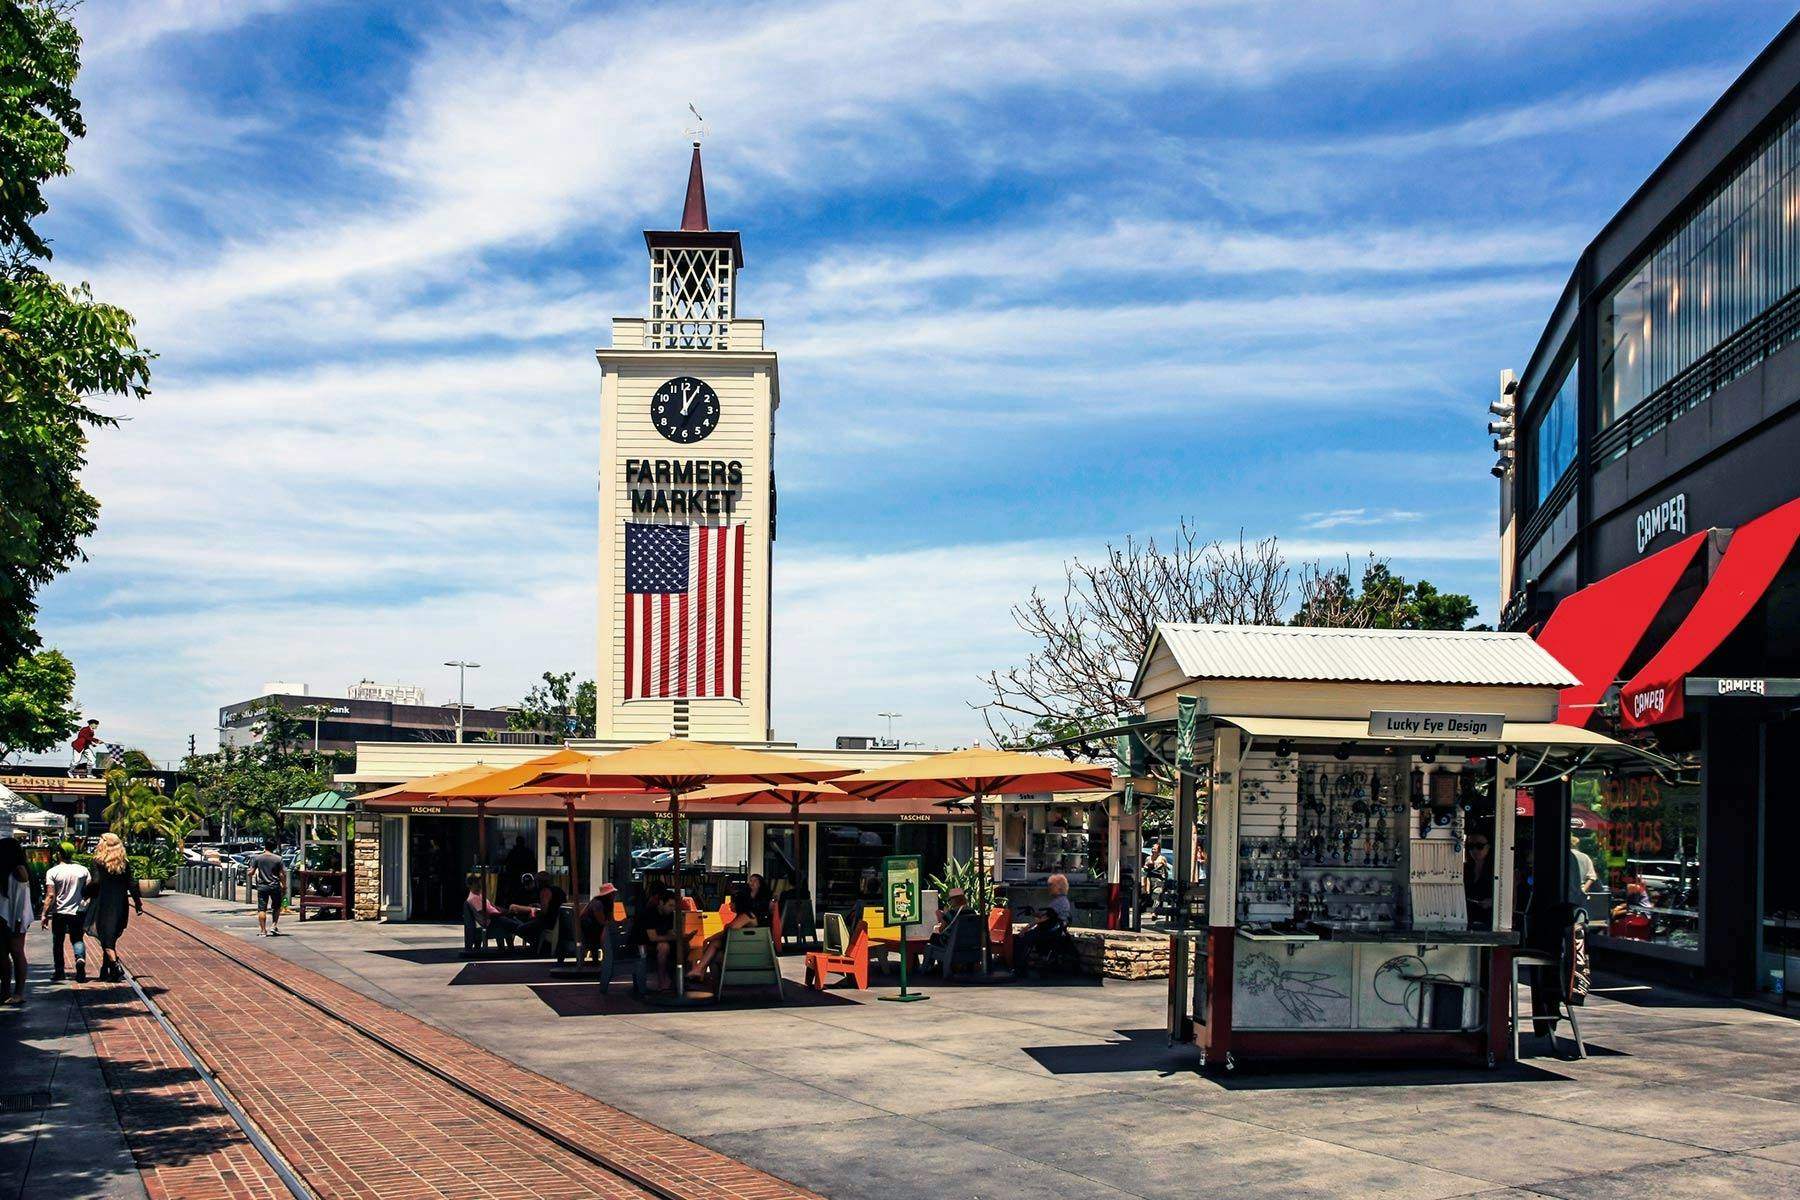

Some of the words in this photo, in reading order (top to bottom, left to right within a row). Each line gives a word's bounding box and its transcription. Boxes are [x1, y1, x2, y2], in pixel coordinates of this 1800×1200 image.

[670, 385, 677, 394] 11
[681, 382, 691, 391] 12
[660, 393, 670, 402] 10
[704, 394, 710, 403] 2
[658, 405, 665, 414] 9
[707, 406, 714, 415] 3
[660, 417, 668, 426] 8
[702, 418, 710, 427] 4
[670, 426, 677, 435] 7
[681, 429, 688, 438] 6
[694, 426, 701, 435] 5
[626, 459, 743, 484] FARMERS
[632, 489, 736, 514] MARKET
[1637, 493, 1686, 553] CAMPER
[1718, 679, 1765, 695] CAMPER
[1634, 688, 1665, 718] CAMPER
[1387, 718, 1420, 733] Lucky
[1423, 718, 1444, 733] Eye
[1448, 719, 1488, 735] Design
